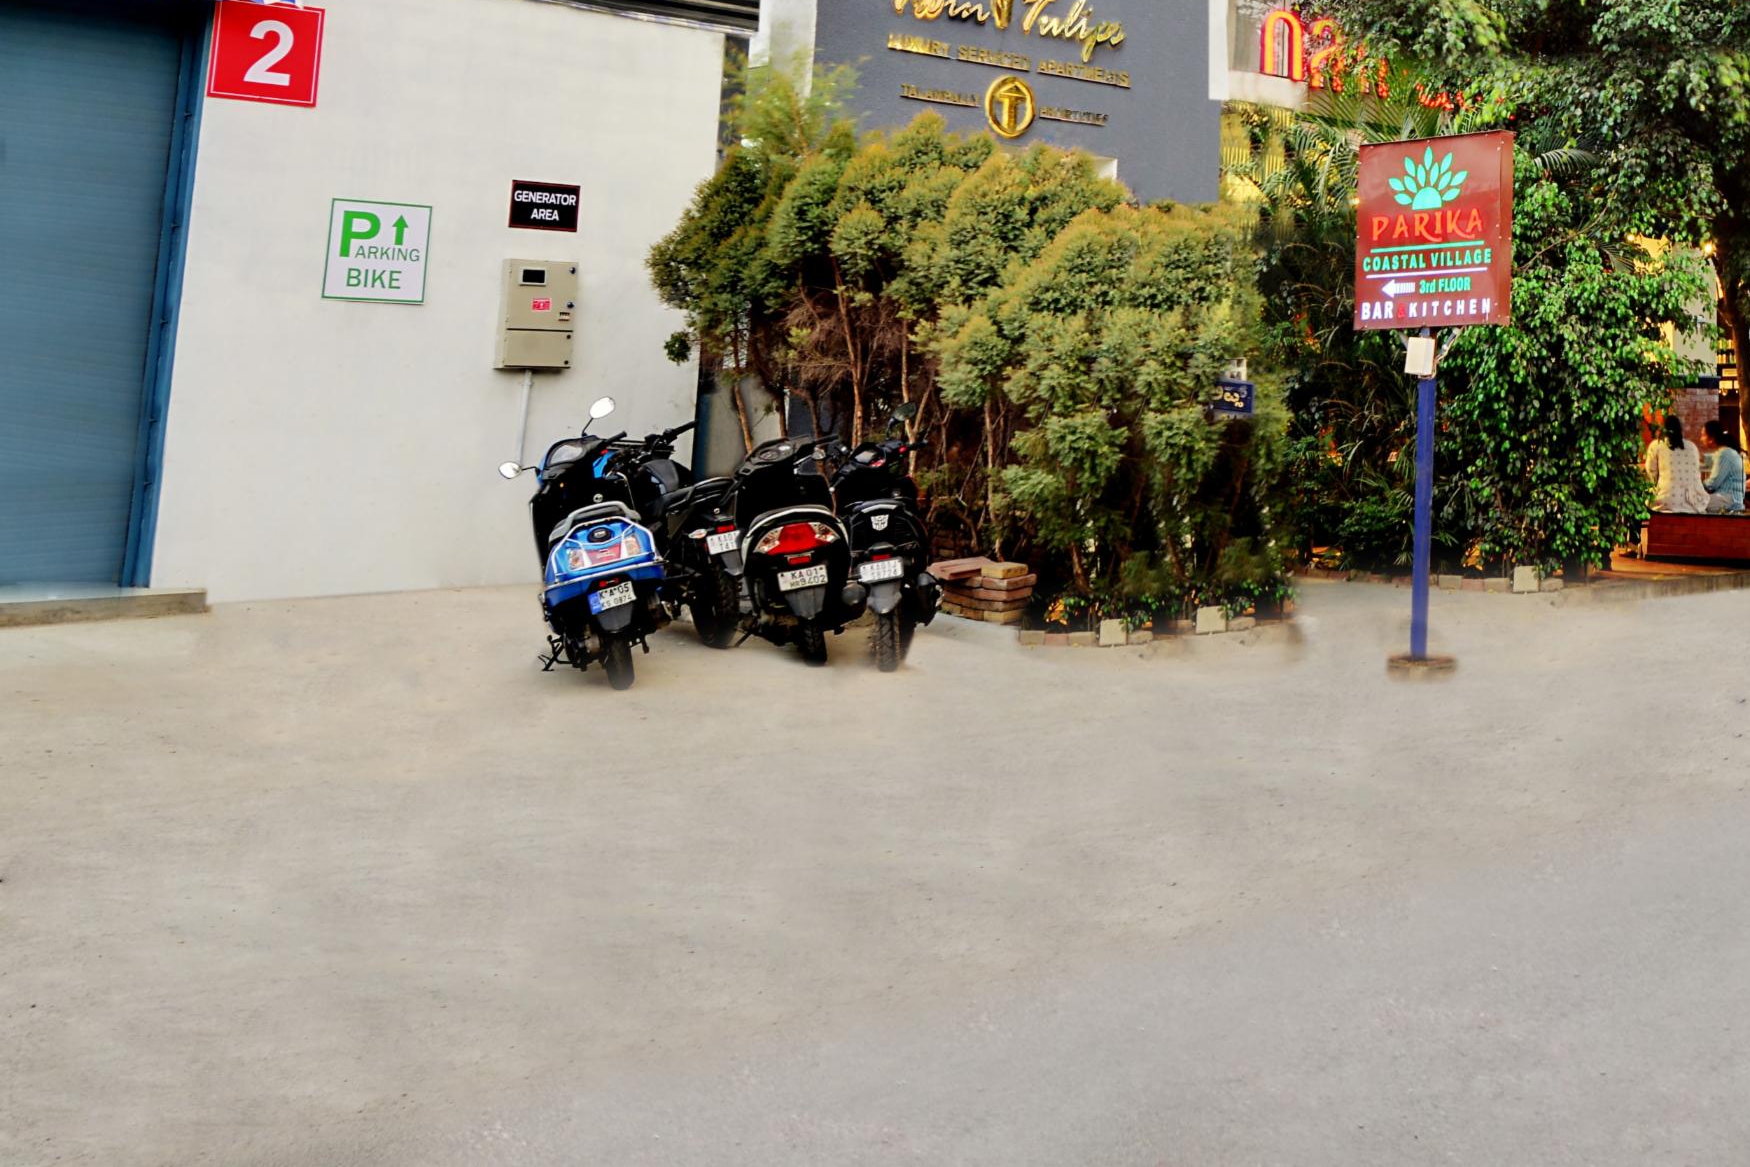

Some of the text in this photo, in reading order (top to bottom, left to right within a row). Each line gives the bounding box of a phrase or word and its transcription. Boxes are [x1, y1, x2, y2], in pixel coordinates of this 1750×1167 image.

[243, 20, 294, 87] 2
[887, 33, 1131, 89] LUXURY SERVICED APARTMENTS
[513, 190, 577, 207] GENERATOR
[530, 208, 560, 222] AREA
[1371, 208, 1483, 242] PARIKA
[339, 210, 421, 262] PARKING
[1362, 248, 1492, 272] COASTAL VILLAGE
[346, 267, 402, 289] BIKE
[1419, 276, 1471, 294] 3rd FLOOR
[1361, 301, 1393, 320] BAR
[1408, 298, 1491, 319] KITCHEN
